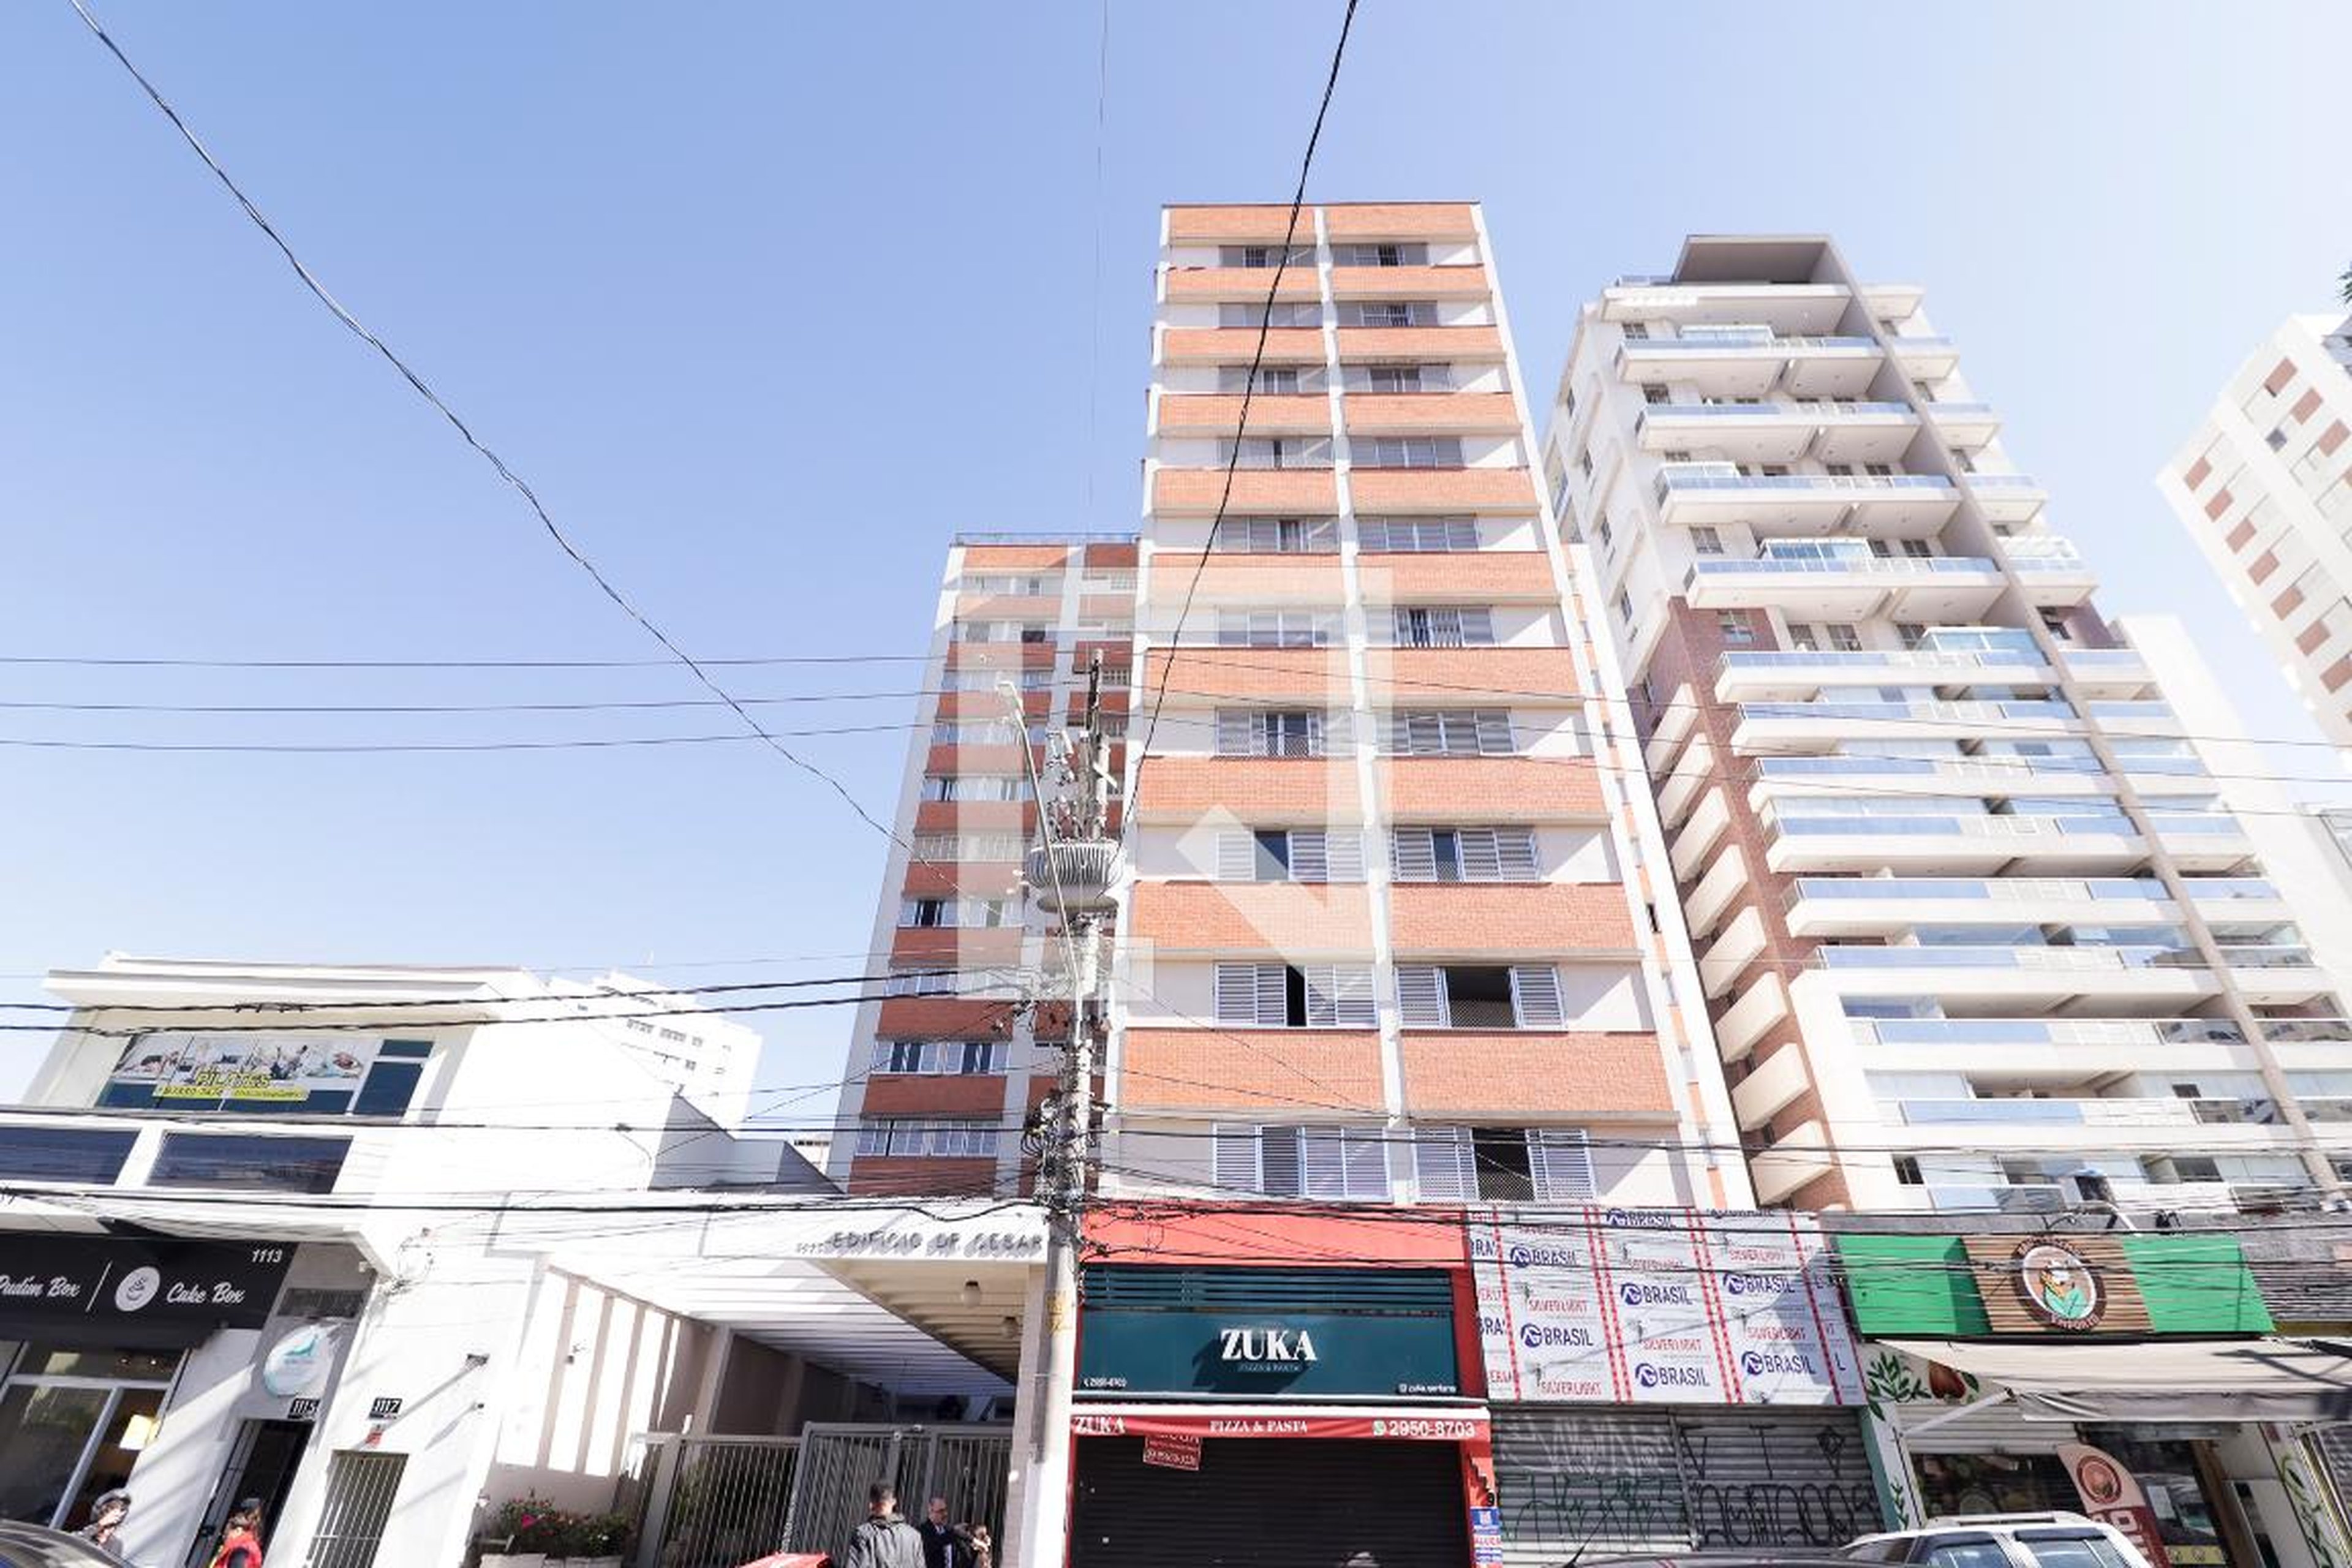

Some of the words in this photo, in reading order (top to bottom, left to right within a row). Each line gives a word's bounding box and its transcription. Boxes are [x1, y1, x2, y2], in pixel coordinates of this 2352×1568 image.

[252, 1249, 283, 1263] 1113
[1532, 1250, 1577, 1267] BRASIL
[47, 1276, 80, 1297] Box
[167, 1281, 205, 1303] Cake
[211, 1282, 245, 1303] Box
[1747, 1275, 1795, 1294] BRASIL
[1643, 1285, 1693, 1305] BRASIL
[1219, 1328, 1317, 1361] ZUKA
[1545, 1326, 1594, 1346] BRASIL
[1764, 1354, 1817, 1374] BRASIL
[1659, 1366, 1710, 1387] BRASIL
[1073, 1416, 1126, 1436] ZUKA
[1210, 1420, 1252, 1433] PIZZA
[1253, 1420, 1264, 1433] &
[1266, 1420, 1308, 1434] PASTA
[1389, 1420, 1476, 1437] 2950-8703
